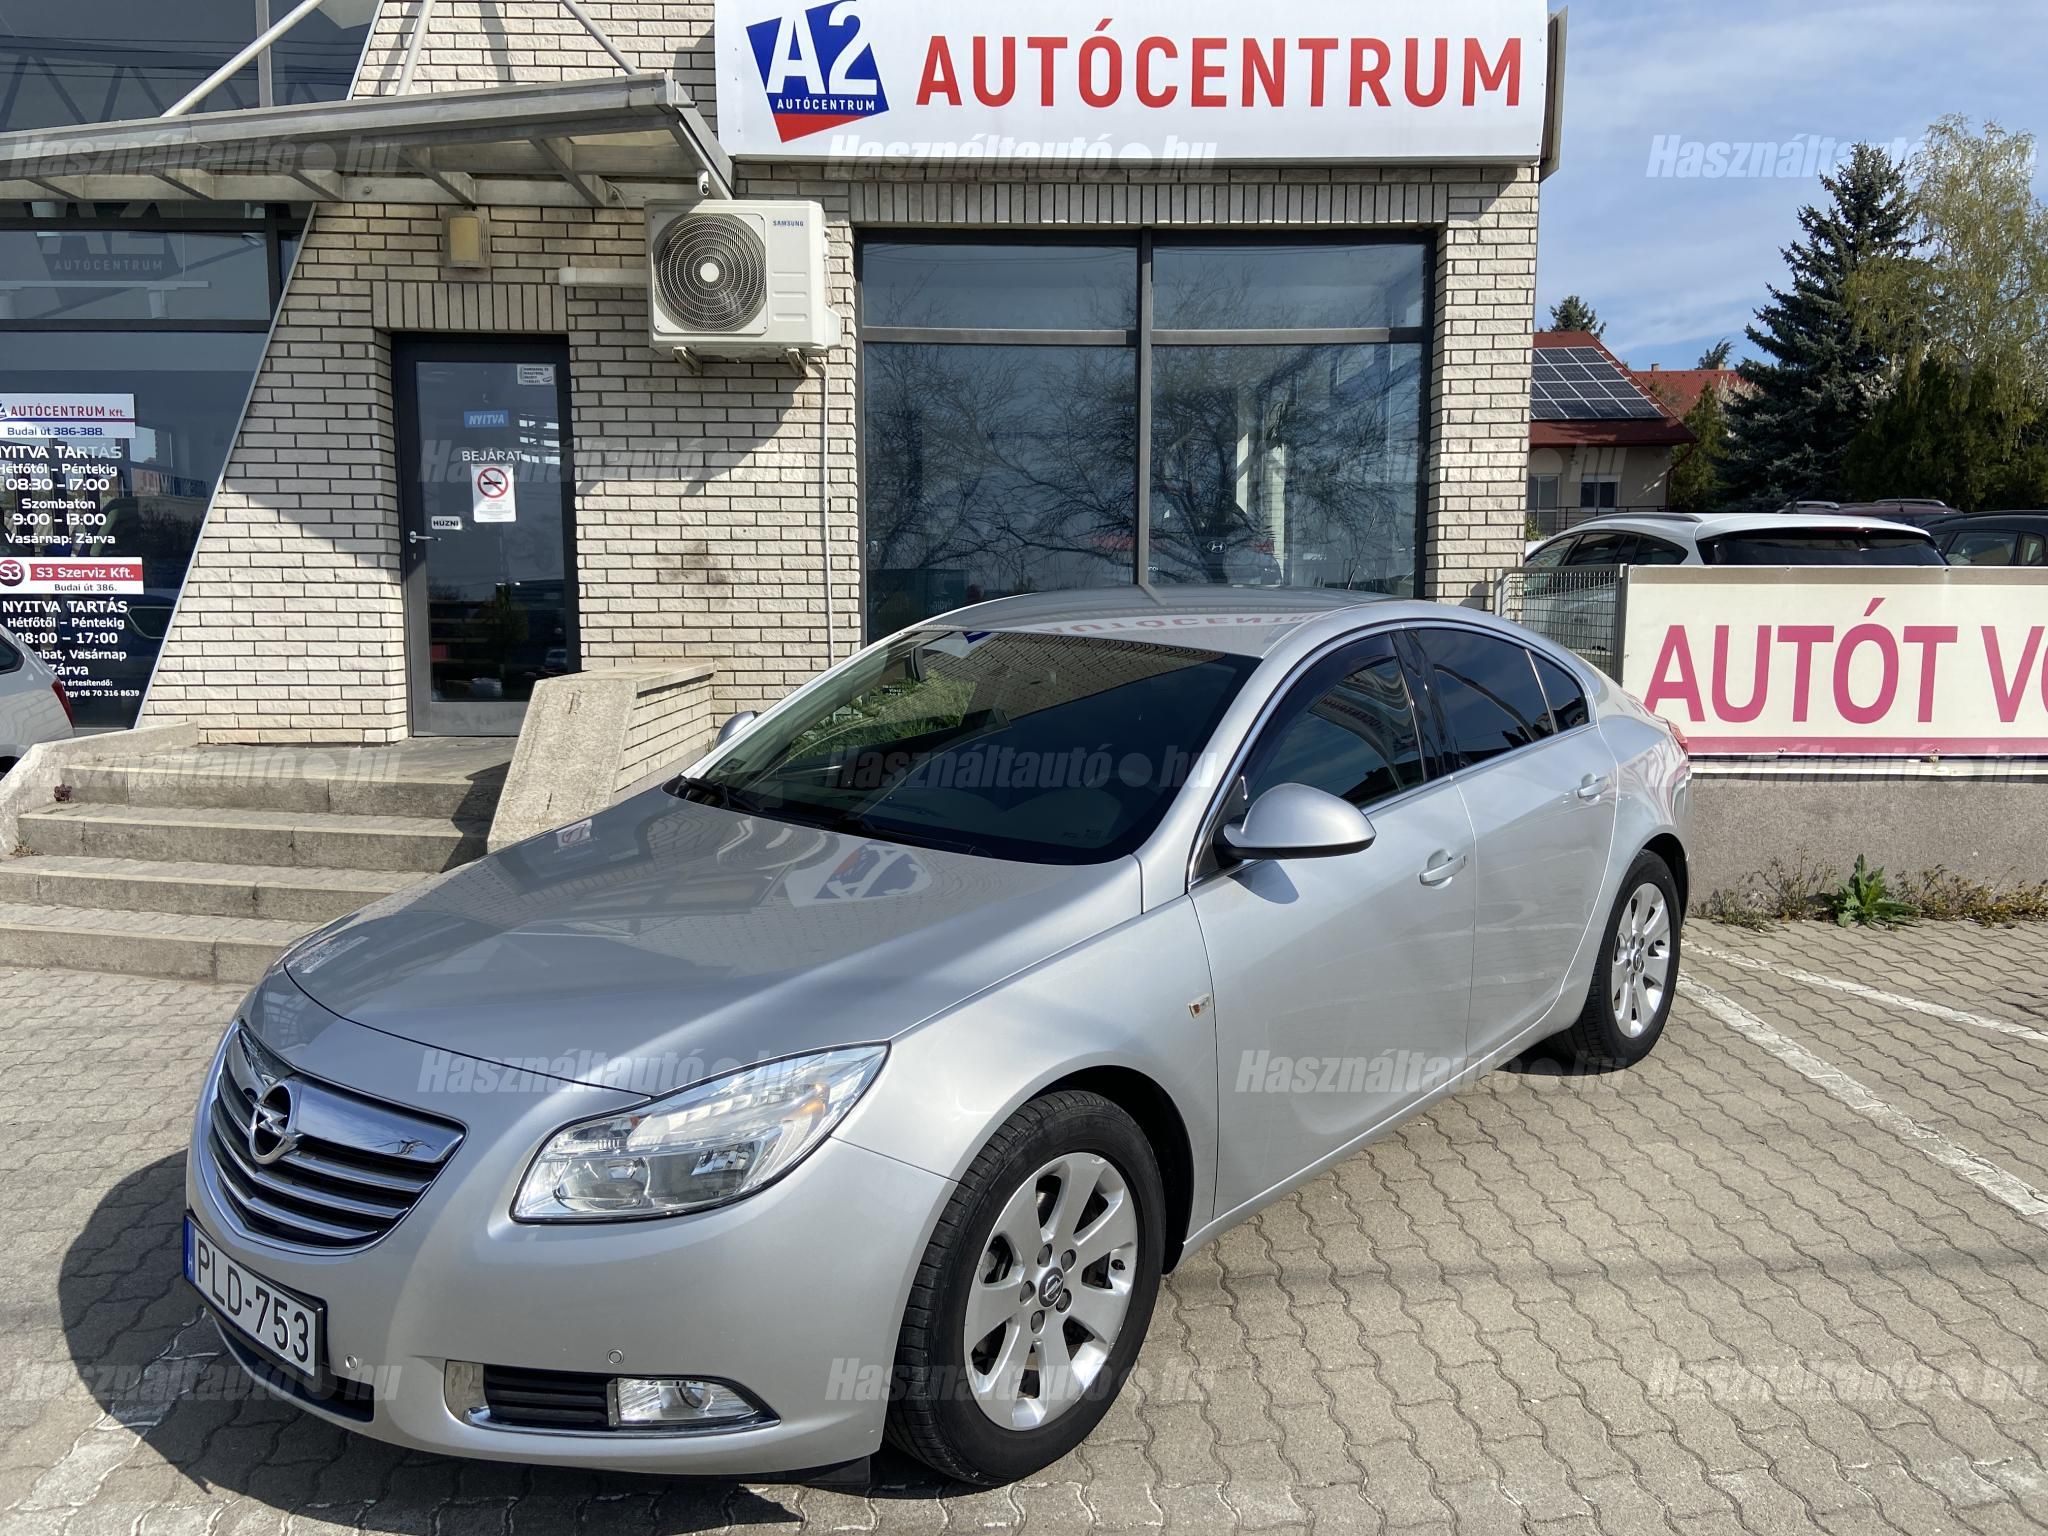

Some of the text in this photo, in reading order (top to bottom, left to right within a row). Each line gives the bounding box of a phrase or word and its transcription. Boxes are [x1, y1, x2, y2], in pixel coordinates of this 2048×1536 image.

[765, 0, 878, 95] A2
[916, 18, 1521, 108] AUTÓCENTRUM
[777, 97, 875, 111] AUTÓCENTRUM
[10, 403, 105, 416] AUTÓCENTRUM
[7, 426, 105, 436] Budai út 386-388.
[55, 442, 122, 459] TARTÁS
[461, 448, 522, 461] BEJÁRAT
[62, 463, 118, 477] Péntekig
[6, 478, 53, 491] 08:30
[69, 478, 110, 491] 17:00
[22, 498, 96, 509] Szombaton
[12, 513, 50, 525] 9:00
[66, 513, 107, 525] 13:00
[5, 532, 116, 546] Vasárnap: Zárva
[36, 566, 134, 578] S3 Szerviz Kft.
[54, 582, 118, 592] Budai út 386.
[2, 597, 128, 613] NYITVA TARTÁS
[7, 617, 56, 628] Hétfőtől
[71, 617, 125, 629] Péntekig
[76, 632, 118, 644] 17:00
[35, 648, 127, 661] bat, Vasárnap
[1643, 597, 2048, 724] AUTÓT V
[198, 1238, 309, 1363] PLD-753
